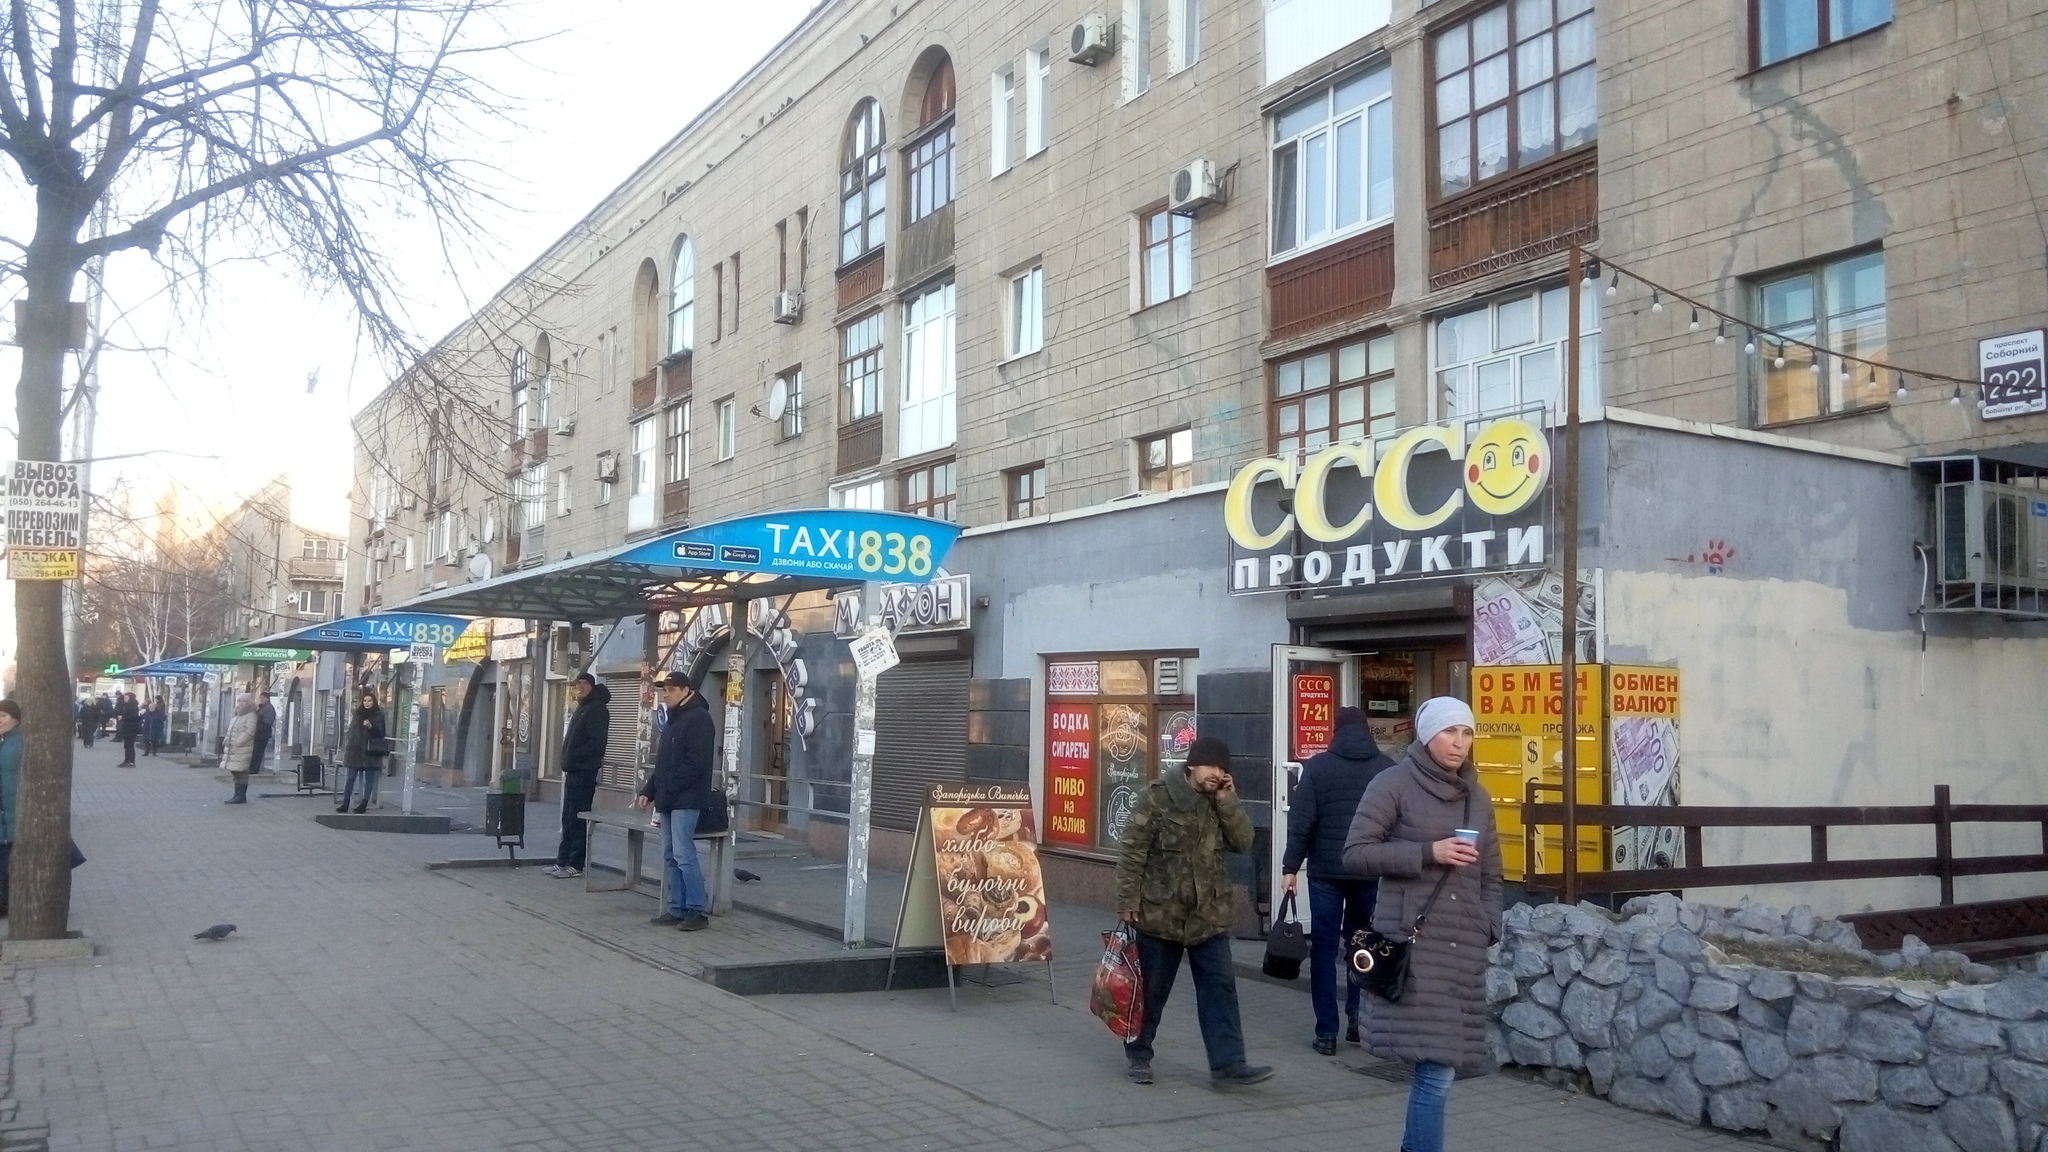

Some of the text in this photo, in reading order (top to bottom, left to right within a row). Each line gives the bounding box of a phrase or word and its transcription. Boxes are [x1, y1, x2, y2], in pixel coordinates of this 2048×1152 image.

[1986, 344, 2038, 360] Соборний
[1994, 338, 2028, 349] проспект
[1989, 367, 2037, 399] 222
[14, 462, 77, 482] ВЫВОЗ
[8, 479, 80, 499] МУСОРА
[9, 498, 32, 507] (050)
[8, 510, 79, 531] ПЕРЕВОЗИМ
[8, 529, 78, 547] МЕБЕЛЬ
[772, 558, 805, 567] ДЗВОНИ
[823, 562, 853, 571] СКАЧАЙ
[1234, 525, 1544, 590] ПРОДУКТИ
[833, 583, 961, 635] МАФОН
[1476, 597, 1512, 620] 500
[1480, 671, 1587, 692] ОБМЕН
[1613, 673, 1678, 692] ОБМЕН
[1481, 695, 1588, 715] ВАЛЮТ
[1613, 695, 1677, 714] ВАЛЮТ
[1053, 712, 1089, 733] ВОДКА
[1476, 723, 1595, 733] ПОКУПКА ПРОЖА
[1052, 741, 1089, 759] СИГАРЕТЫ
[1055, 777, 1085, 797] ПИВО
[1064, 800, 1074, 813] на
[1052, 816, 1085, 834] РАЗЛИВ
[947, 863, 1027, 905] булочні
[951, 900, 1026, 943] вироби
